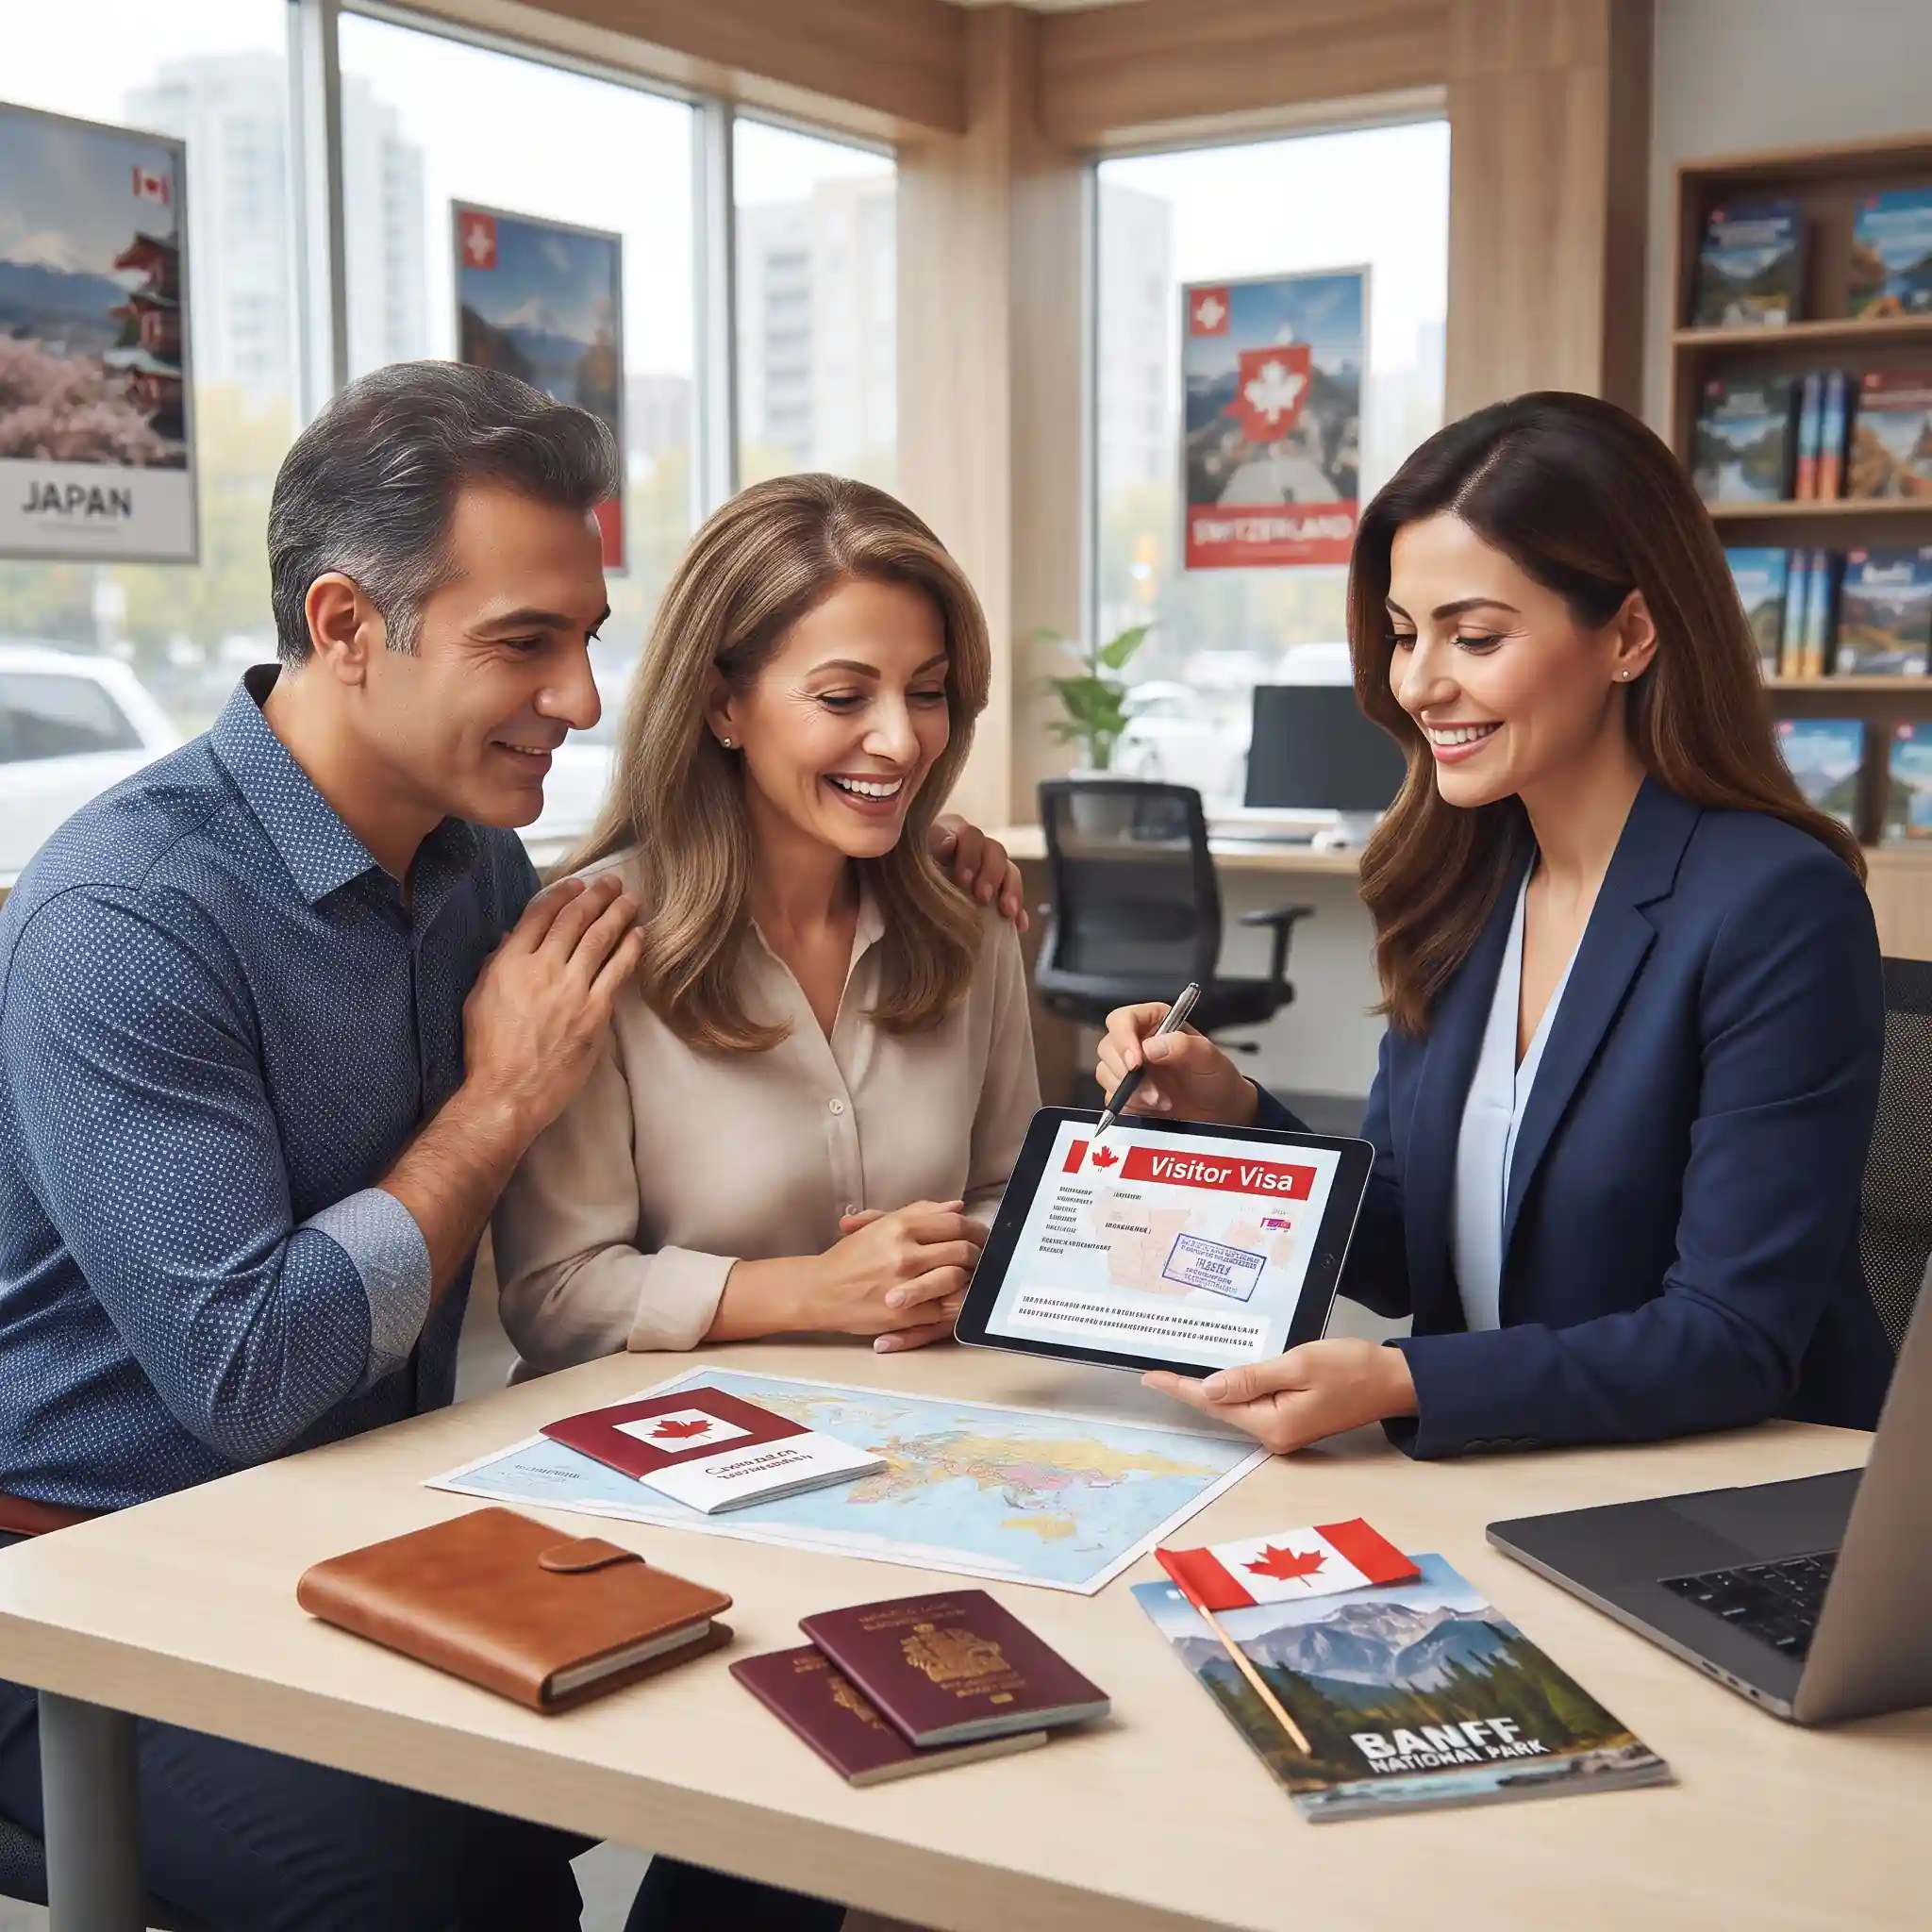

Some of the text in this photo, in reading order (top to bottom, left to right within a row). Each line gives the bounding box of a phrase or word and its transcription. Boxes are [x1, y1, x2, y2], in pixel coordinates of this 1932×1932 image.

[21, 480, 132, 519] JAPAN
[1152, 1156, 1293, 1191] Visitor Visa
[1350, 1717, 1521, 1759] BANFF
[1486, 1739, 1551, 1759] PARK
